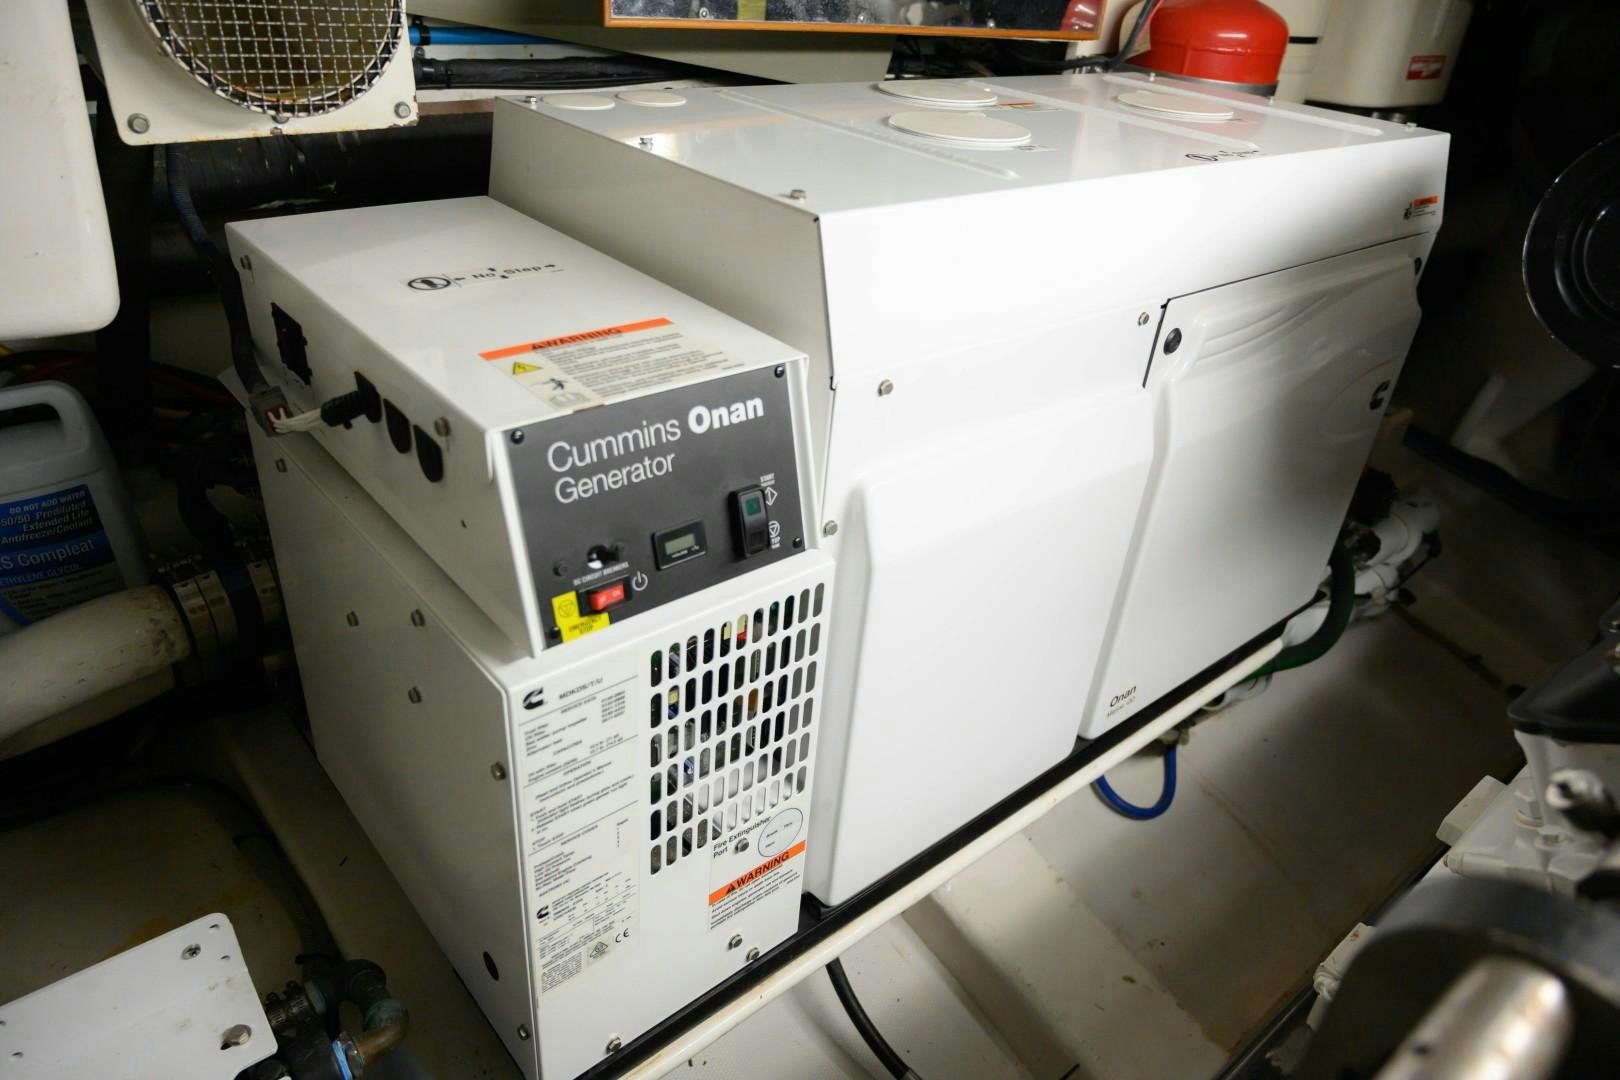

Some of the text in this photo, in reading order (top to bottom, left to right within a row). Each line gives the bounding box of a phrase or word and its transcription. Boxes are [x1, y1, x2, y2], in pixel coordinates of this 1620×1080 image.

[503, 265, 542, 275] Step
[544, 327, 622, 349] WARNING
[547, 397, 765, 473] Cummins Onan
[554, 453, 676, 504] Generator
[0, 500, 87, 527] 50/50 Prediluted
[23, 503, 39, 512] NOT
[41, 498, 58, 507] ADD
[60, 490, 86, 503] WATER
[23, 515, 70, 532] Extended
[17, 538, 96, 568] Compleat
[1110, 685, 1137, 708] Onan
[713, 839, 728, 852] Fire
[728, 815, 772, 843] Extinguisher
[713, 845, 728, 859] Port
[736, 851, 790, 886] WARNING
